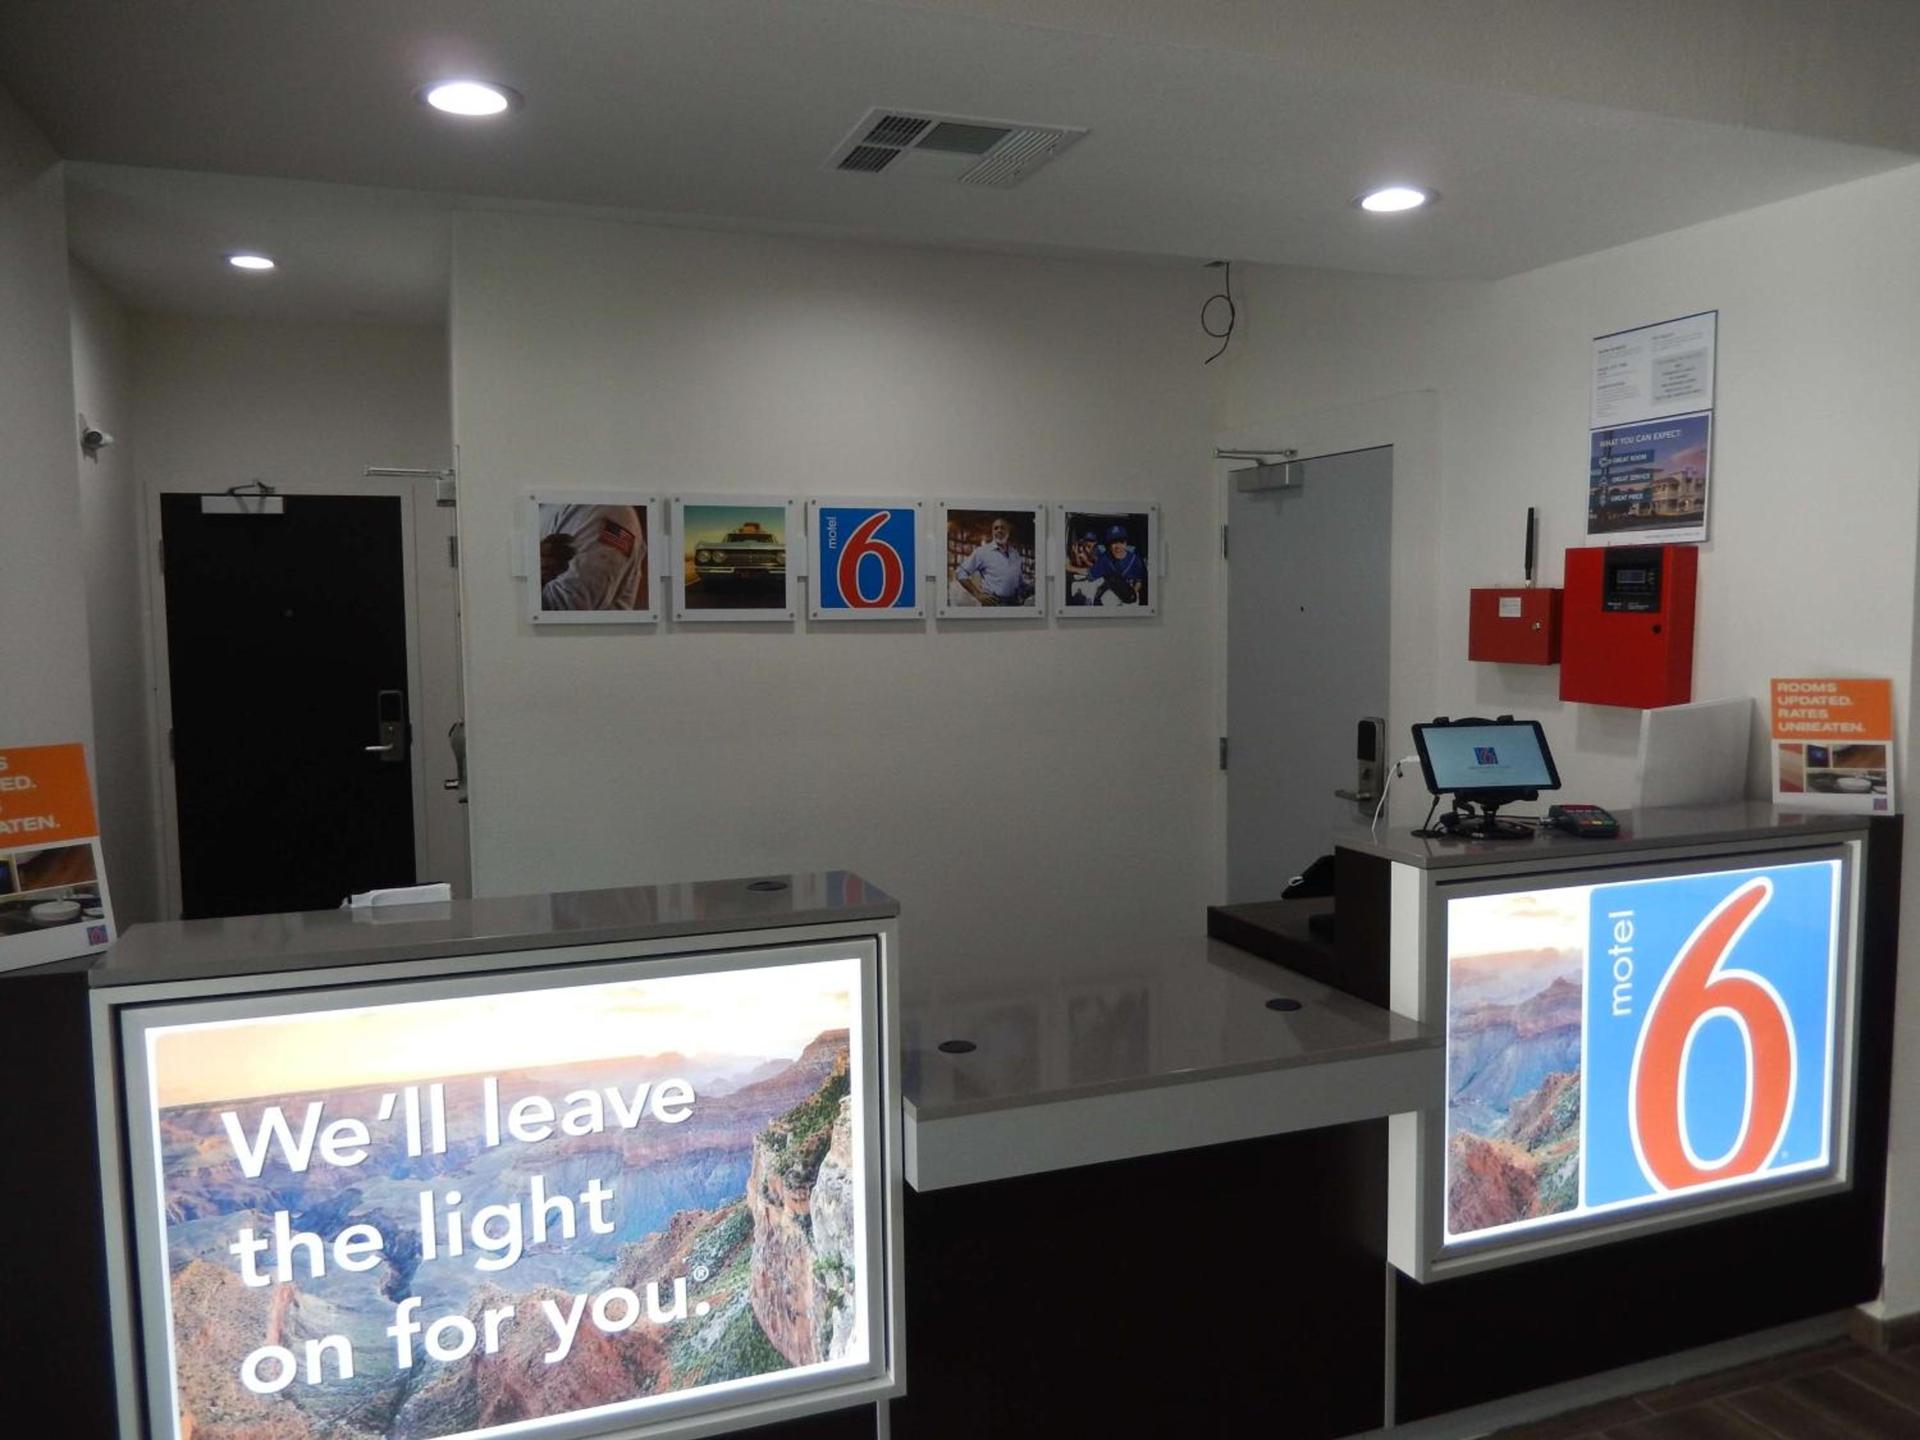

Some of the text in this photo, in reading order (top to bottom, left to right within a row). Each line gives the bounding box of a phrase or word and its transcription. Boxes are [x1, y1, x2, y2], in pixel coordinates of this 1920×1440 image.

[1636, 433, 1652, 443] CAN
[826, 516, 837, 549] motel
[837, 510, 904, 608] 6
[1777, 683, 1838, 692] ROOMS
[1777, 696, 1853, 706] UPDATED.
[1777, 708, 1829, 719] RATES
[1777, 722, 1865, 732] UNBEATEN.
[1609, 909, 1635, 1017] motel
[1628, 876, 1798, 1197] 6
[483, 1077, 696, 1149] leave
[230, 1175, 616, 1288] the light
[240, 1331, 355, 1395] on
[387, 1296, 515, 1369] for
